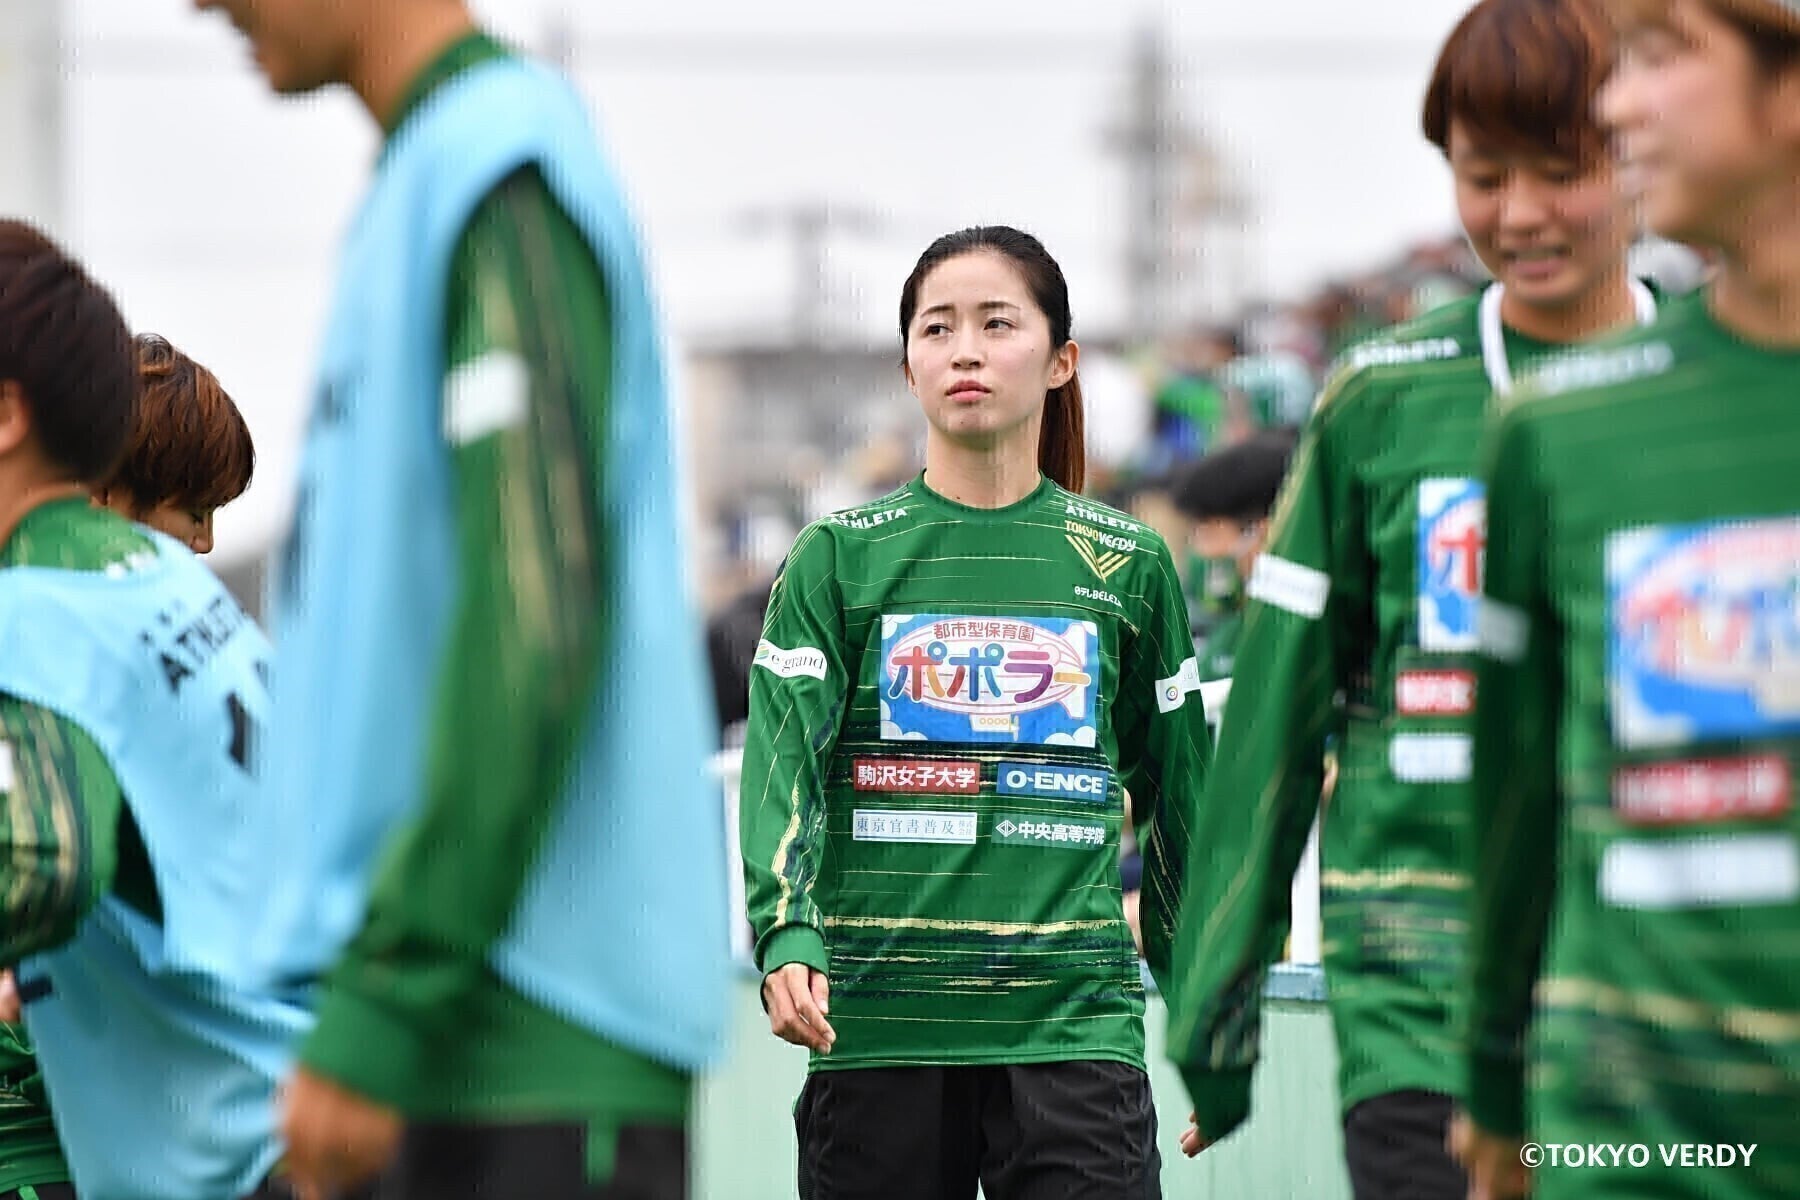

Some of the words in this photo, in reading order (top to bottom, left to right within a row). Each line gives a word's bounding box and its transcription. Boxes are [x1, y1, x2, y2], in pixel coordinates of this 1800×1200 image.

[1065, 504, 1139, 533] ATHLETA
[933, 621, 1035, 643] 都市型保育園
[887, 640, 1092, 704] ポポラー
[857, 765, 976, 789] 駒沢女子大学
[1006, 770, 1104, 795] O-ENCE
[1018, 821, 1105, 845] 中央高等学院
